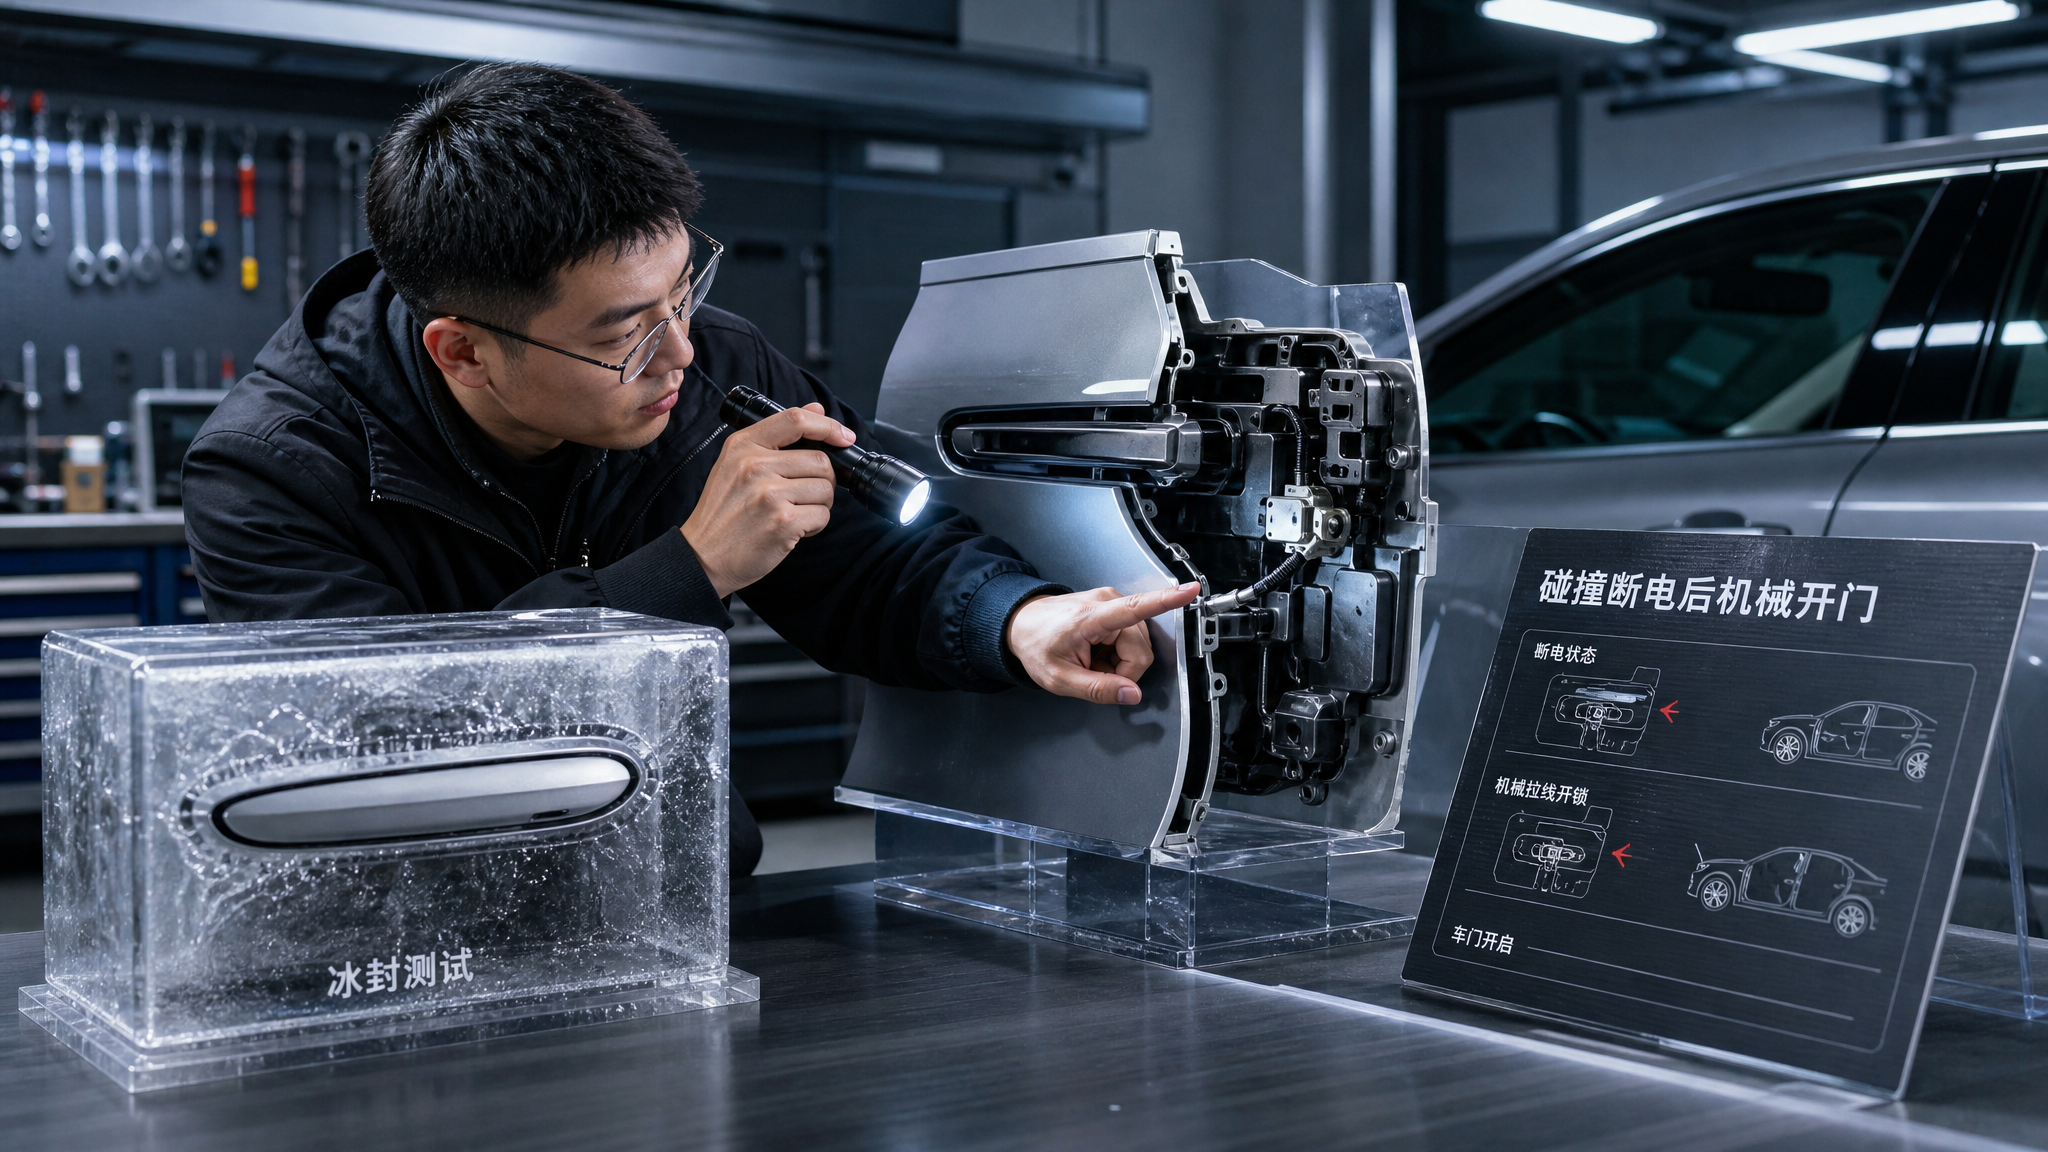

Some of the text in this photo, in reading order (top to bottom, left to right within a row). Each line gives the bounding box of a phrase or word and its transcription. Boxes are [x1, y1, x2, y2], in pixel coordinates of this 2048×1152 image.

[1538, 568, 1879, 623] 碰撞断电后机械开门
[1533, 641, 1598, 665] 断电状态
[1494, 775, 1590, 806] 机械拉线开锁
[1450, 924, 1514, 955] 车门开启
[326, 946, 475, 999] 冰封测试
